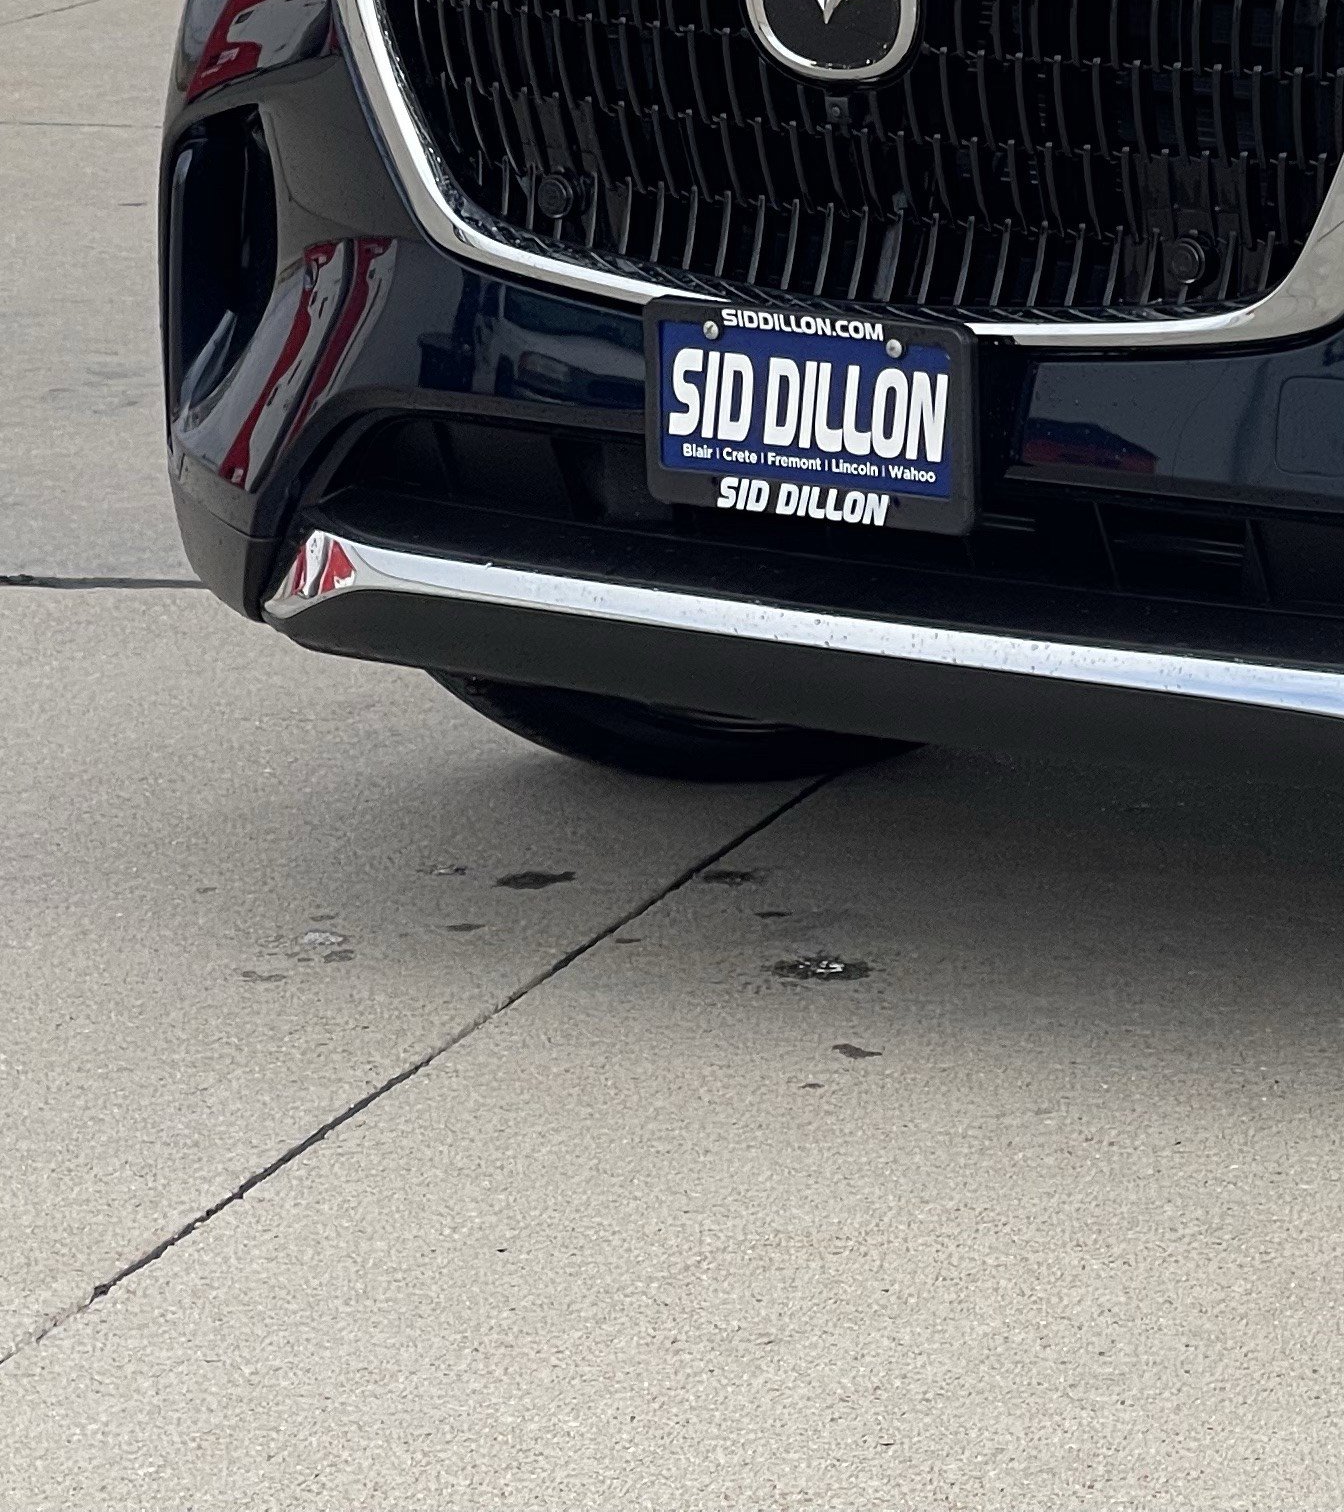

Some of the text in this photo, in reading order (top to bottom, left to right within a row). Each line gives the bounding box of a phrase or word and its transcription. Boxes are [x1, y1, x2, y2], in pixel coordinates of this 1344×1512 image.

[721, 308, 884, 341] SIDDILLON.COM
[668, 348, 950, 463] SID DILLON
[682, 443, 936, 484] Blair Crete Fremont Lincoln Wahoo
[717, 477, 890, 527] SID DILLON
